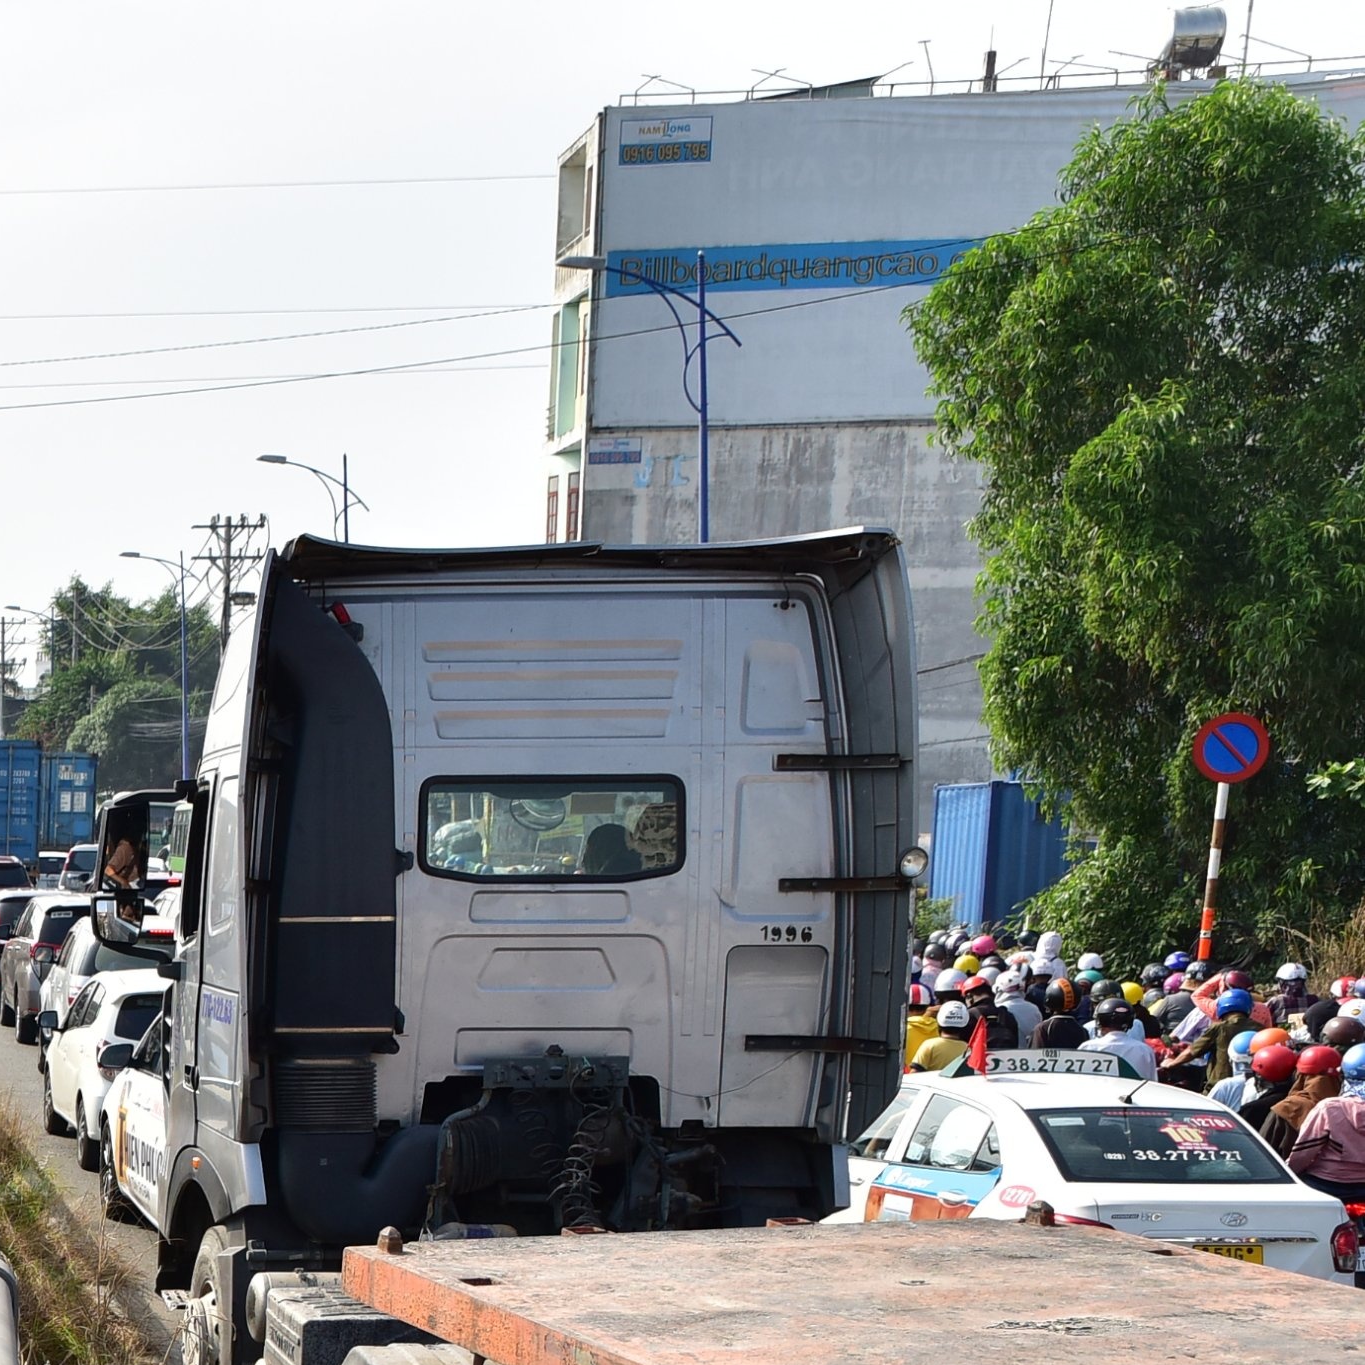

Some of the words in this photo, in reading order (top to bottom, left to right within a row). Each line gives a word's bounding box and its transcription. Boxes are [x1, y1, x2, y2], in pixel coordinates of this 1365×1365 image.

[639, 126, 660, 135] NAM
[623, 146, 654, 162] 0916
[658, 144, 681, 160] 095
[685, 142, 708, 159] 795
[760, 925, 813, 943] 1996
[1007, 1058, 1058, 1072] 38.27
[1064, 1059, 1085, 1072] 27
[1092, 1059, 1113, 1073] 27
[1132, 1149, 1188, 1161] 38.27
[1193, 1151, 1216, 1161] 27
[1220, 1151, 1242, 1161] 27
